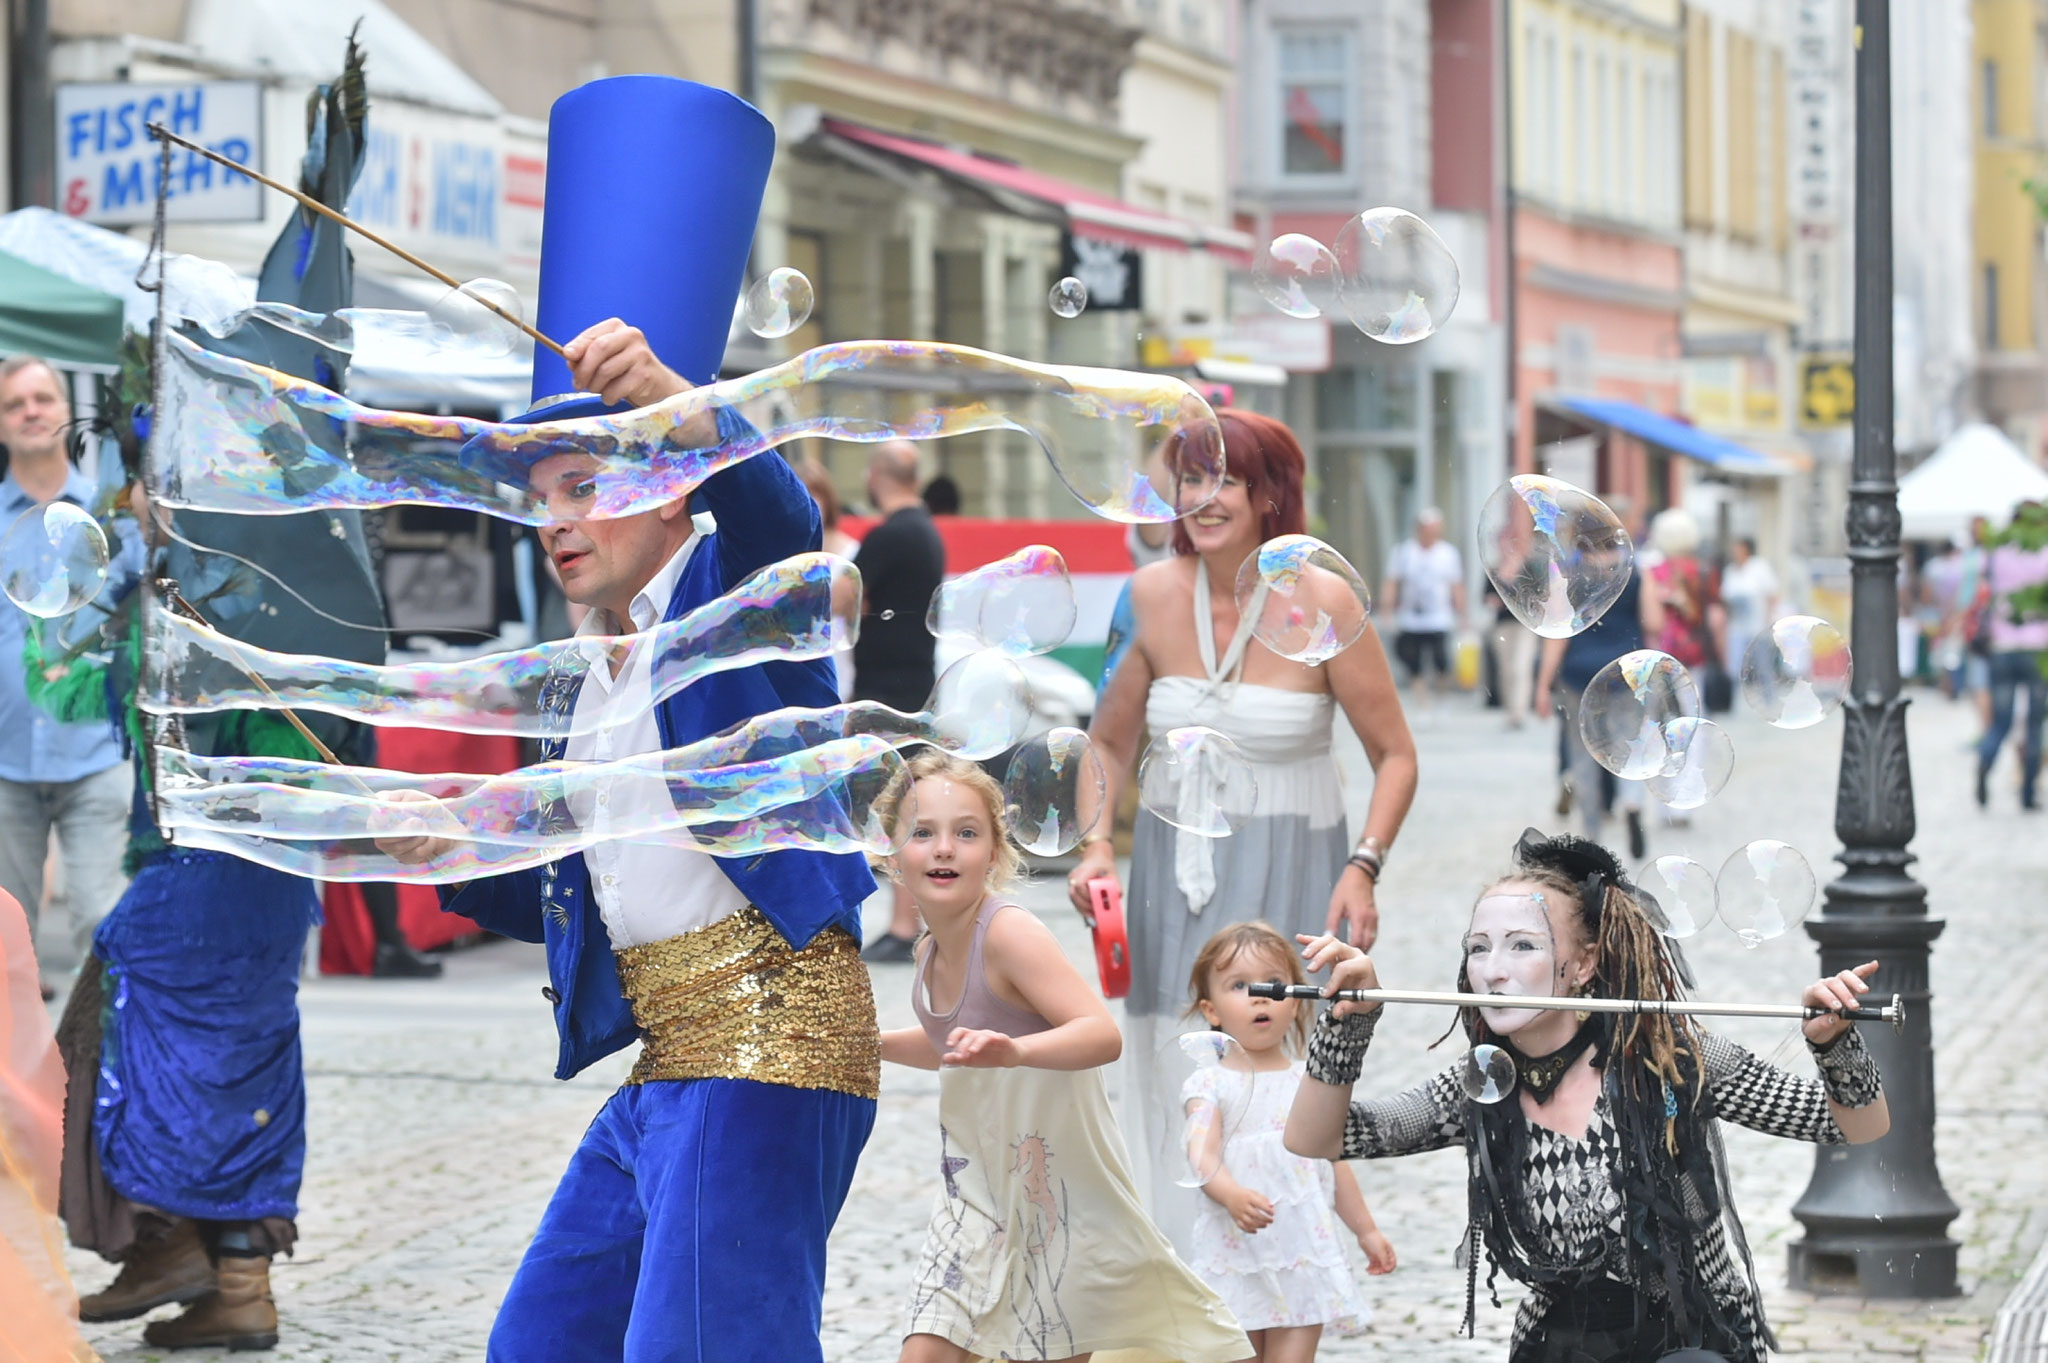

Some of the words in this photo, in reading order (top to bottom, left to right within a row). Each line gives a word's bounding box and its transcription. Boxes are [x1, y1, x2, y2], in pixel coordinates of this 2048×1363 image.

[68, 85, 203, 158] FISCH
[65, 178, 90, 217] &
[102, 137, 251, 210] MEHR
